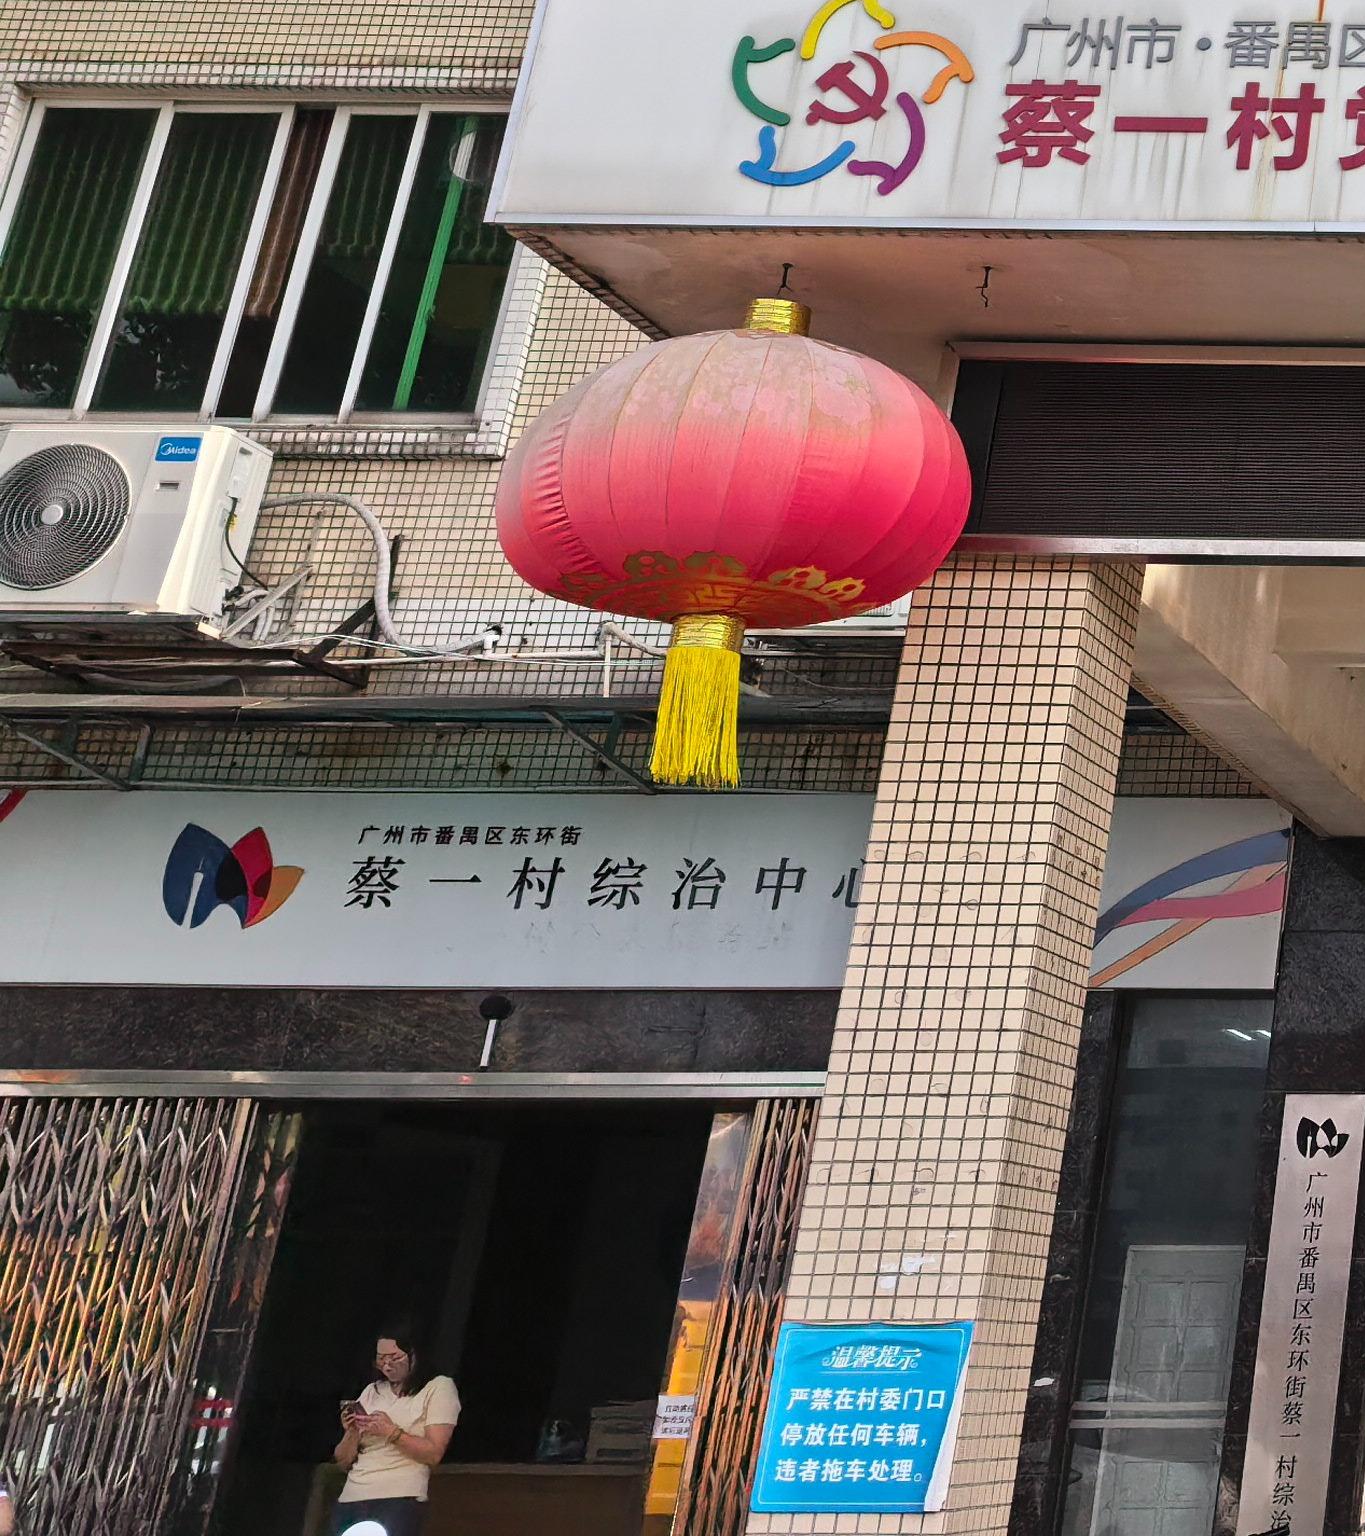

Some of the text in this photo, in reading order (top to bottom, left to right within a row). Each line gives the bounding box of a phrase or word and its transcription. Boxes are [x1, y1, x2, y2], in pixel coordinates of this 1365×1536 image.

[161, 442, 197, 456] Midea
[358, 825, 584, 847] 广州市番禺区东环街
[822, 1344, 922, 1371] 温馨提示
[786, 1387, 947, 1411] 严禁在村委门口
